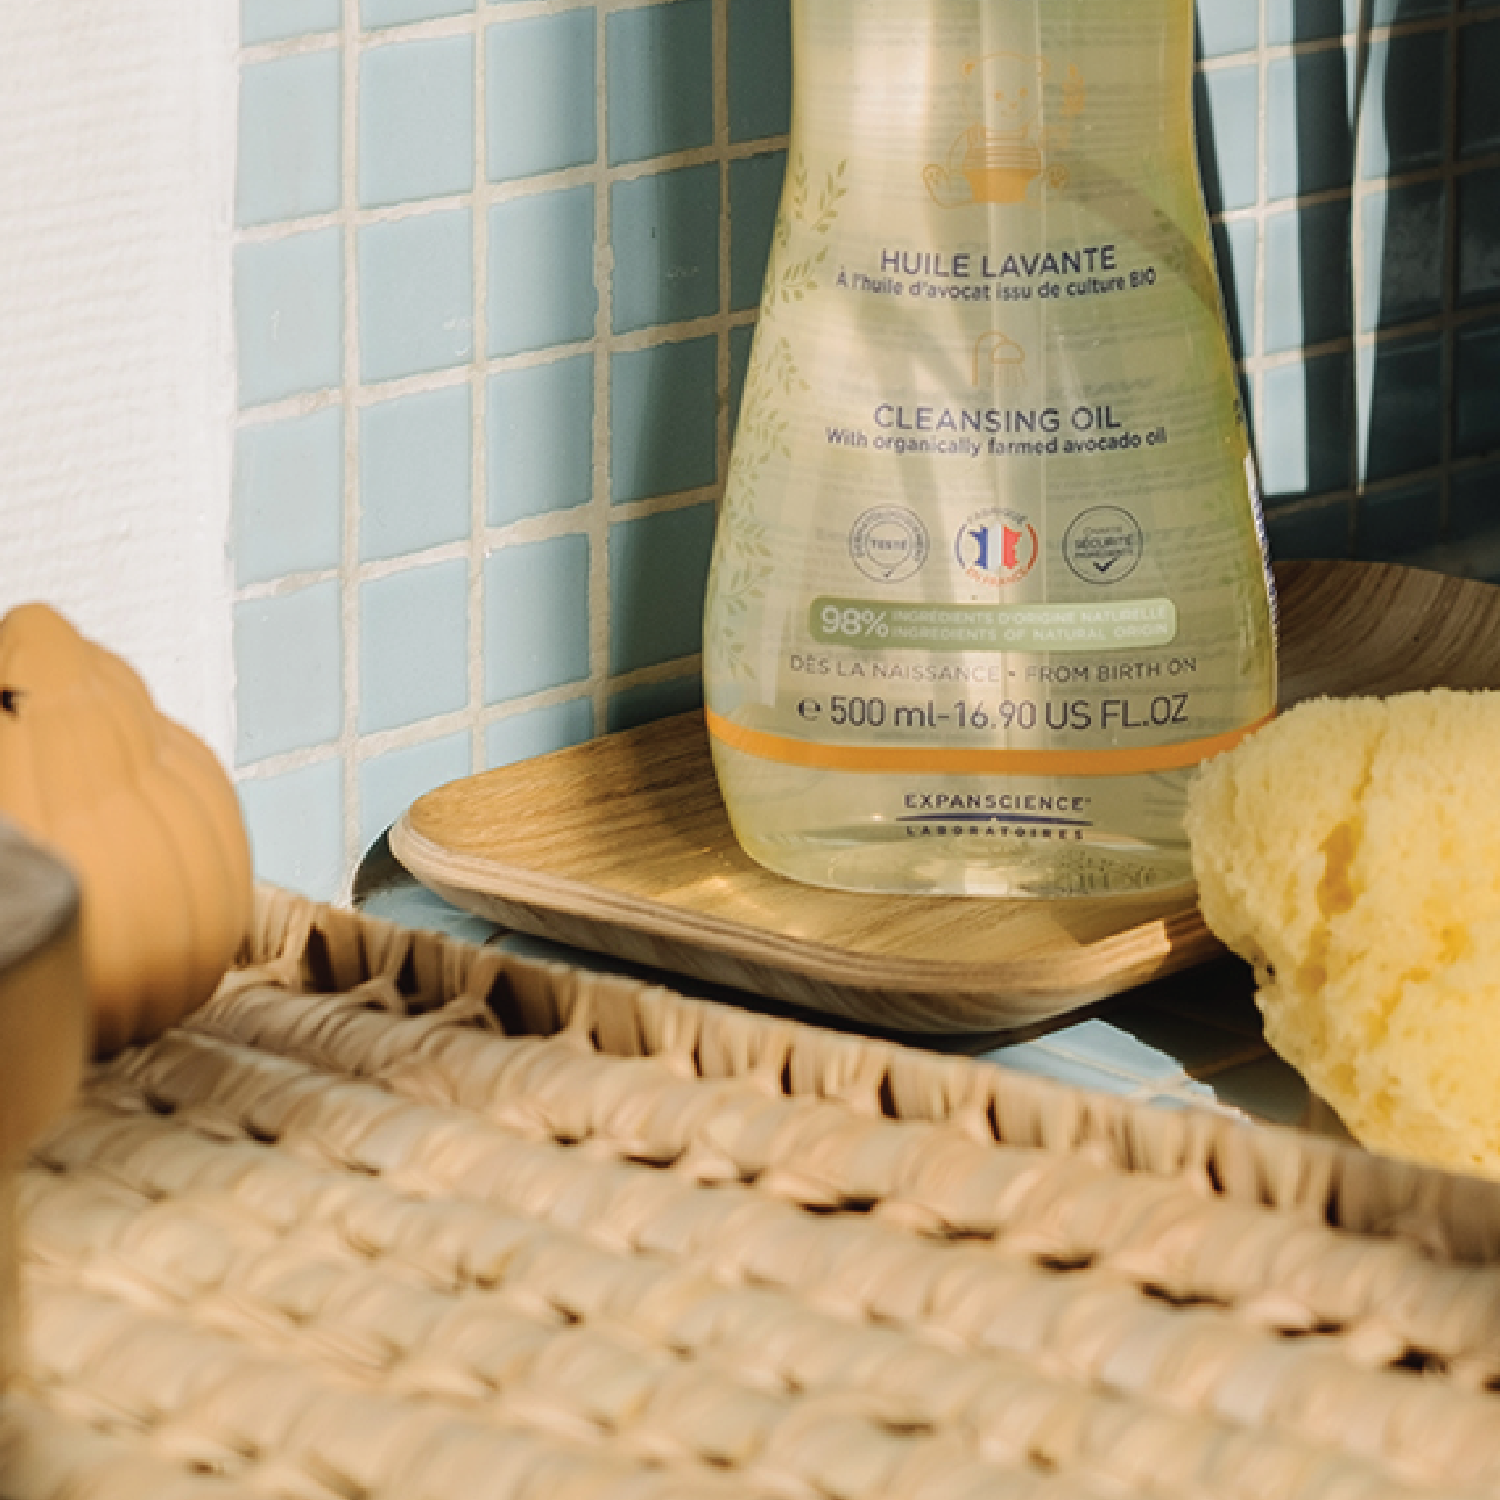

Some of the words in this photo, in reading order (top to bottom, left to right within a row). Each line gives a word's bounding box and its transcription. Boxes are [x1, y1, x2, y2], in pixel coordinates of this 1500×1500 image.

[881, 248, 971, 278] HUILE
[981, 244, 1118, 278] LAVANTE
[909, 279, 991, 300] d'avocat
[995, 281, 1031, 300] issu
[1037, 280, 1061, 298] de
[1066, 275, 1126, 296] culture
[873, 403, 1061, 433] CLEANSING
[1071, 404, 1122, 431] OIL
[826, 427, 868, 448] With
[873, 433, 981, 457] organically
[987, 435, 1058, 454] farmed
[1063, 431, 1142, 454] avocado
[1145, 426, 1168, 445] oil
[820, 605, 889, 637] 98%
[789, 653, 831, 676] DÈS
[836, 661, 865, 677] LA
[872, 662, 1000, 683] NAISSANCE
[1024, 665, 1089, 683] FROM
[1096, 662, 1160, 683] BIRTH
[1167, 657, 1197, 677] ON
[829, 696, 887, 726] 500
[1045, 700, 1092, 730] US
[1101, 691, 1189, 730] FL.OZ
[903, 794, 1084, 811] EXPANSCIENCE
[906, 825, 1084, 840] LABORATOIRES
